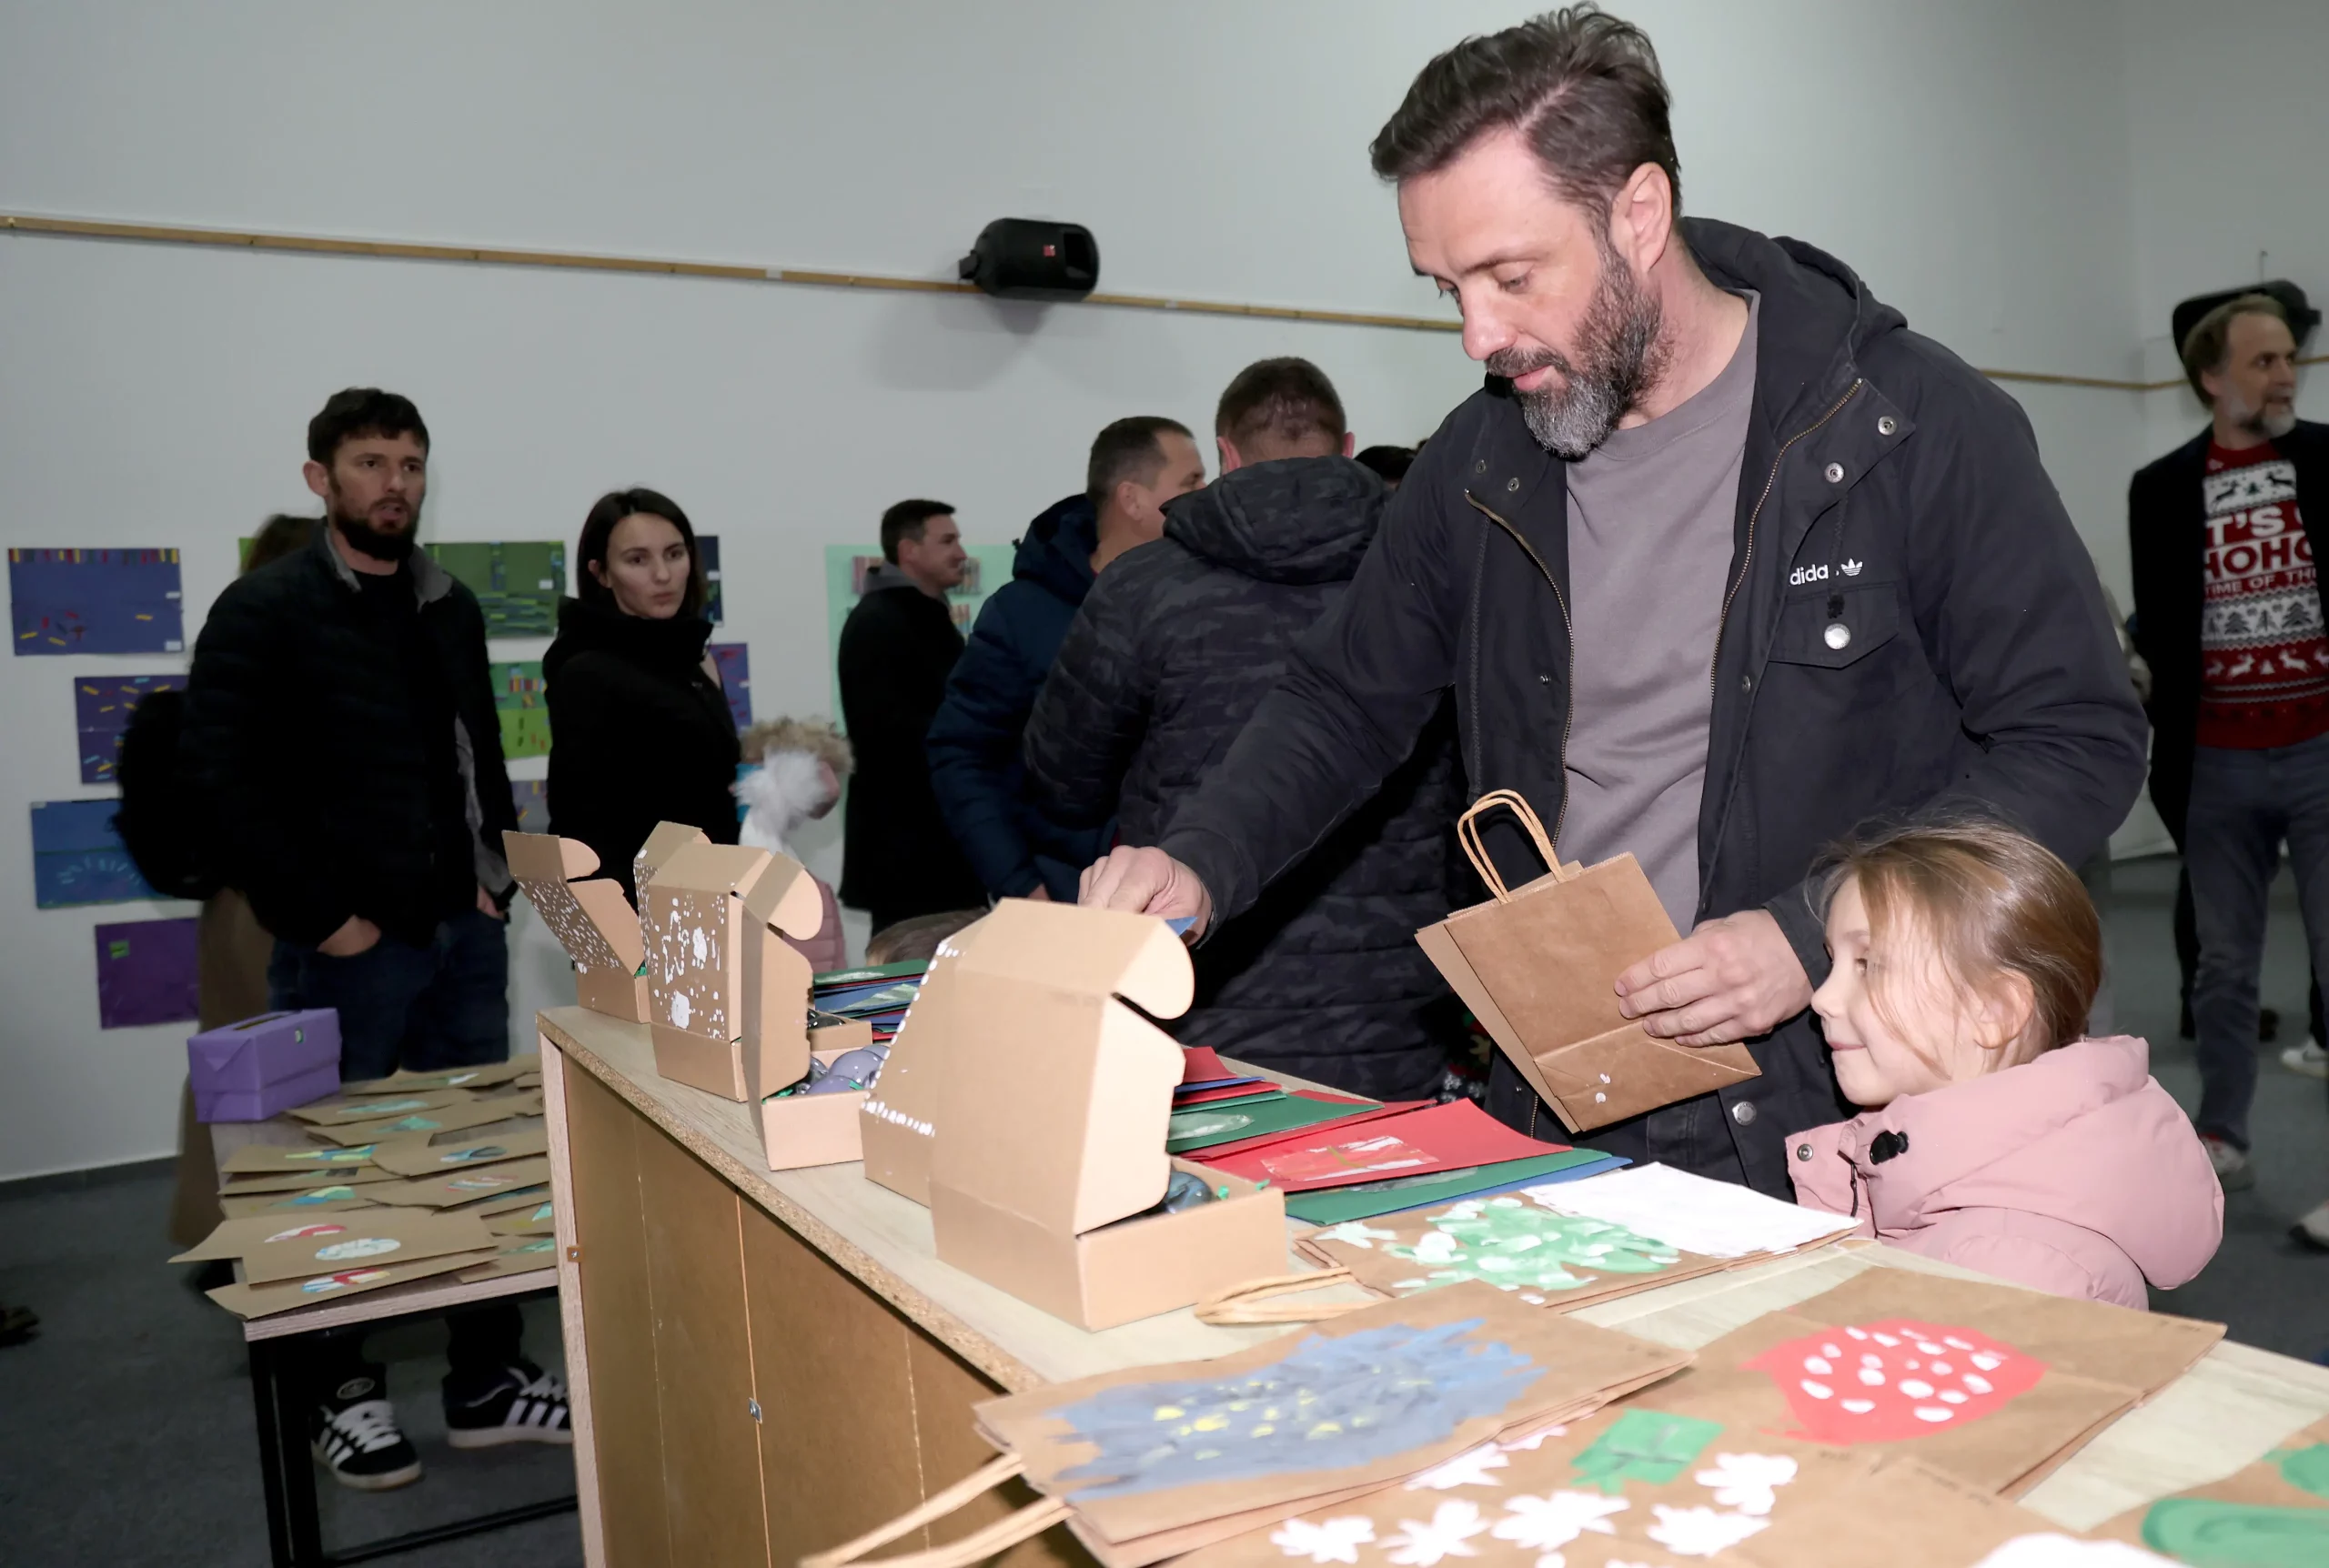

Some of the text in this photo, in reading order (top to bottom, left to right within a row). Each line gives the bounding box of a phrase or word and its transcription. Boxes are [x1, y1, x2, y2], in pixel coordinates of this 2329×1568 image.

[2205, 505, 2285, 546] T'S
[1790, 564, 1840, 586] dida
[2249, 575, 2275, 588] OF
